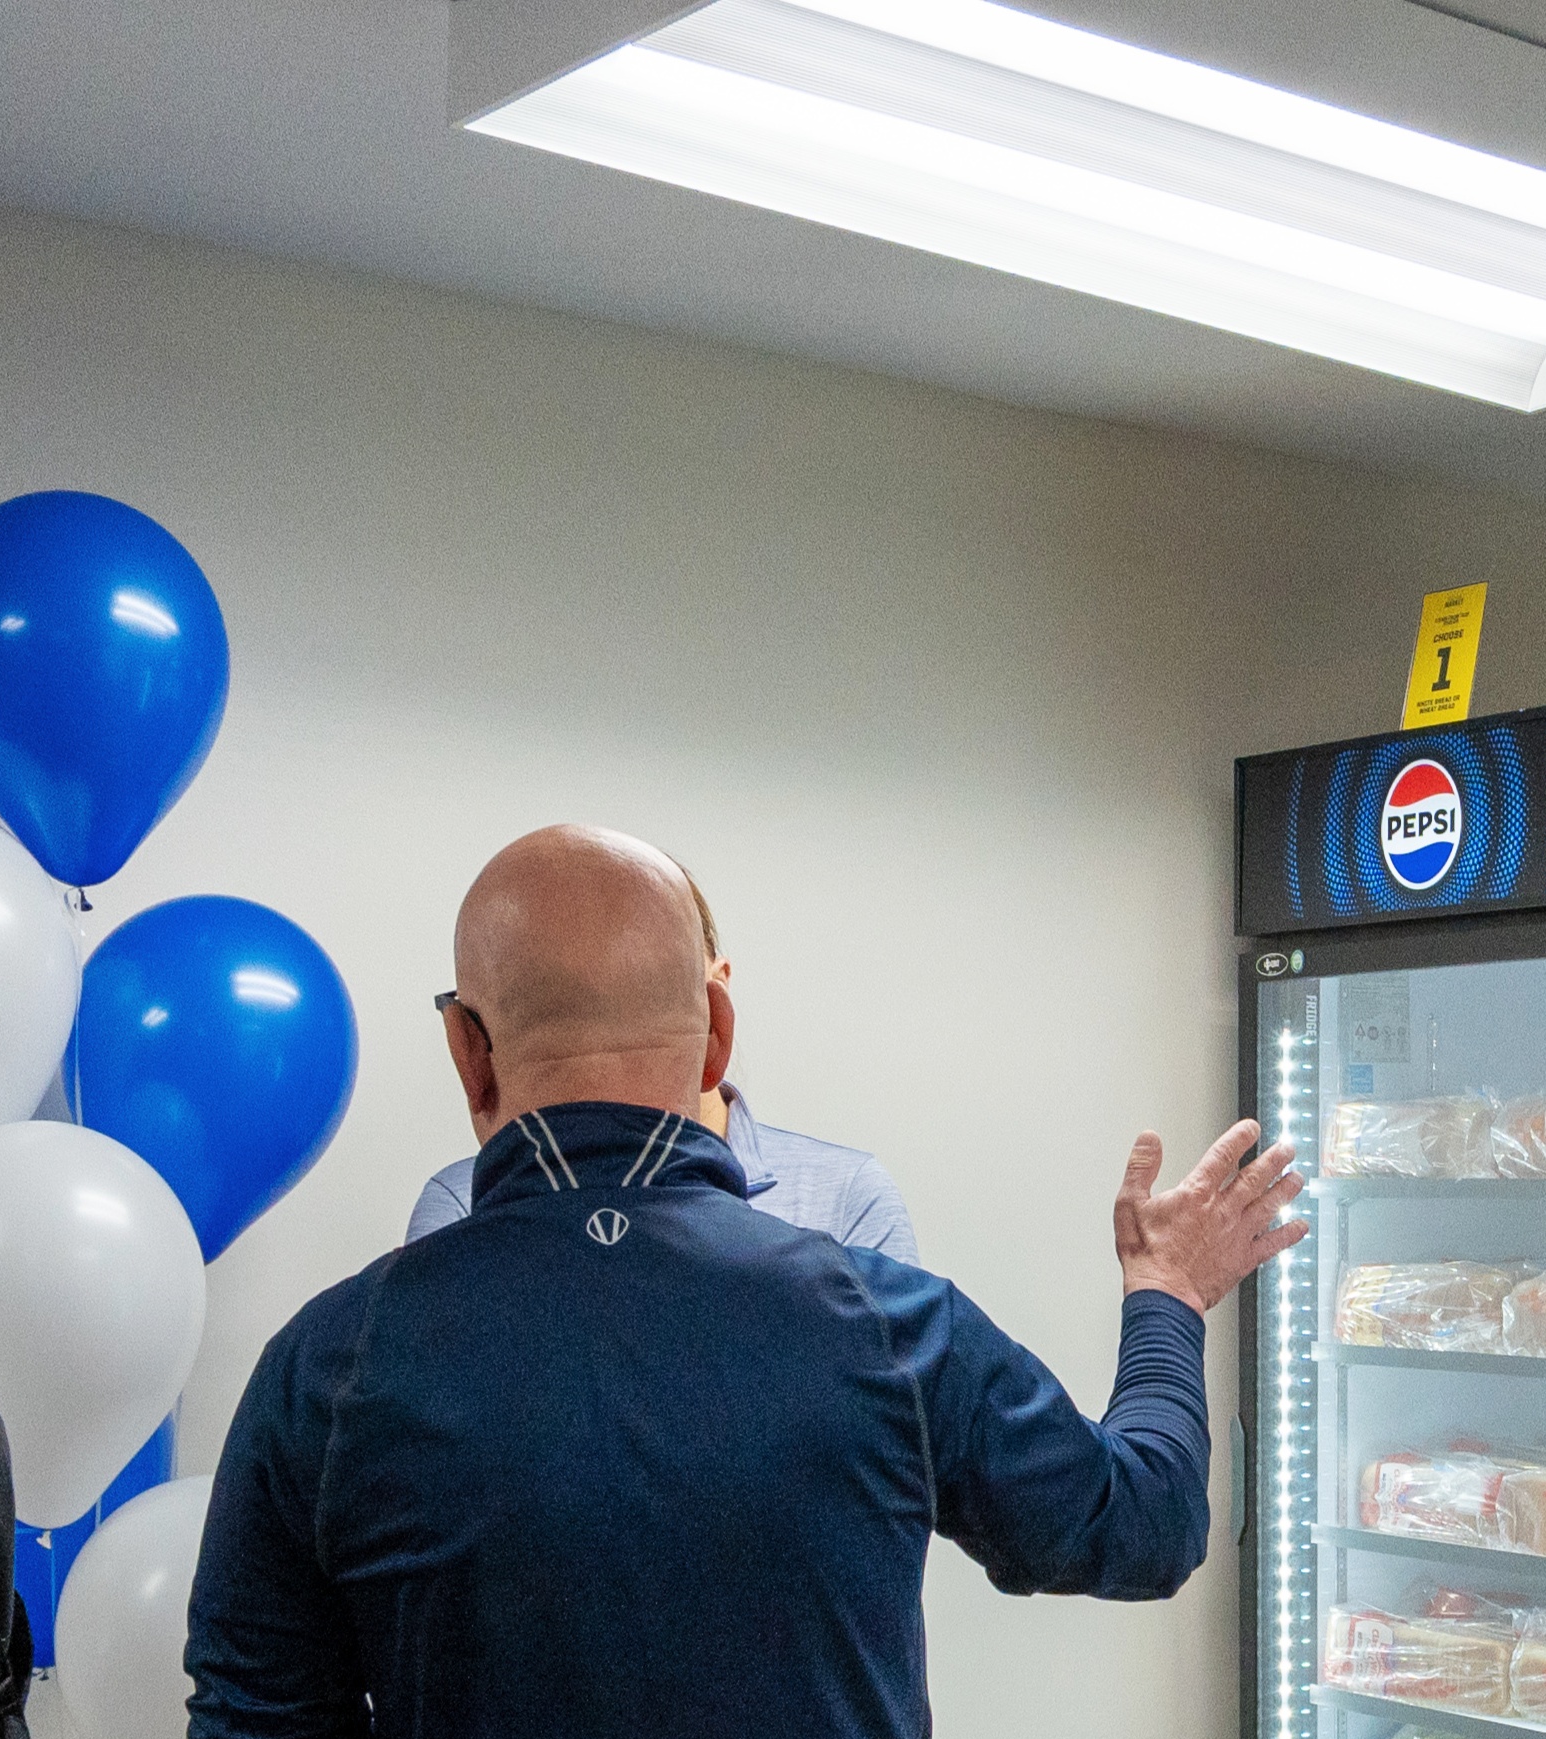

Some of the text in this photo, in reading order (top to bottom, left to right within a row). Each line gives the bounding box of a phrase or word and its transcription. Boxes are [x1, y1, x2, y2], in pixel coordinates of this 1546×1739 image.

[1433, 629, 1464, 643] CHOOSE
[1431, 646, 1452, 692] 1
[1387, 807, 1457, 842] PEPSI
[1305, 995, 1317, 1037] FRIDGE
